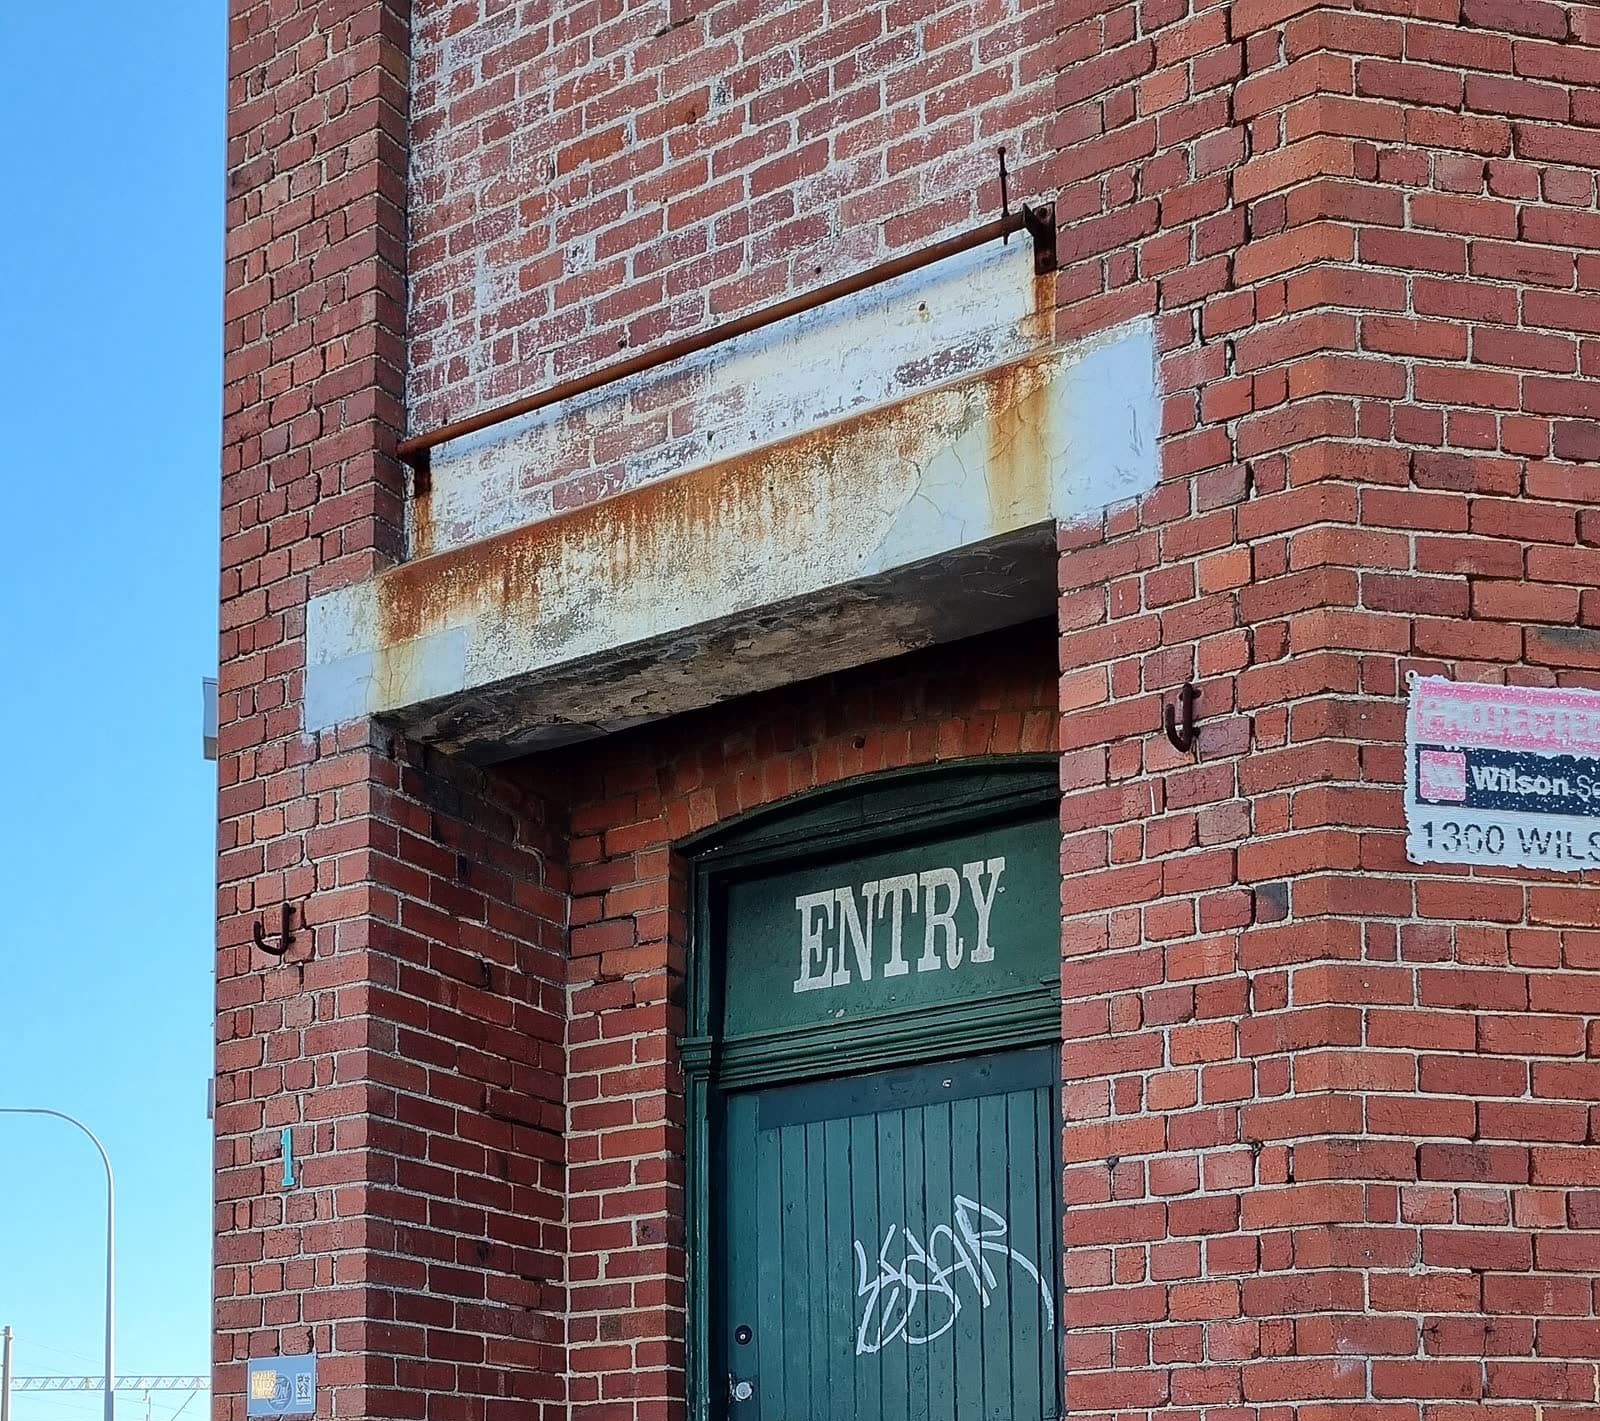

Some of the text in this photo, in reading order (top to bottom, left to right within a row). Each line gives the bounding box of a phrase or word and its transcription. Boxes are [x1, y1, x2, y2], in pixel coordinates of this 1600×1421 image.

[1471, 764, 1569, 796] Wilson
[1422, 820, 1505, 855] 1300
[793, 856, 1006, 993] ENTRY
[281, 1127, 296, 1187] 1
